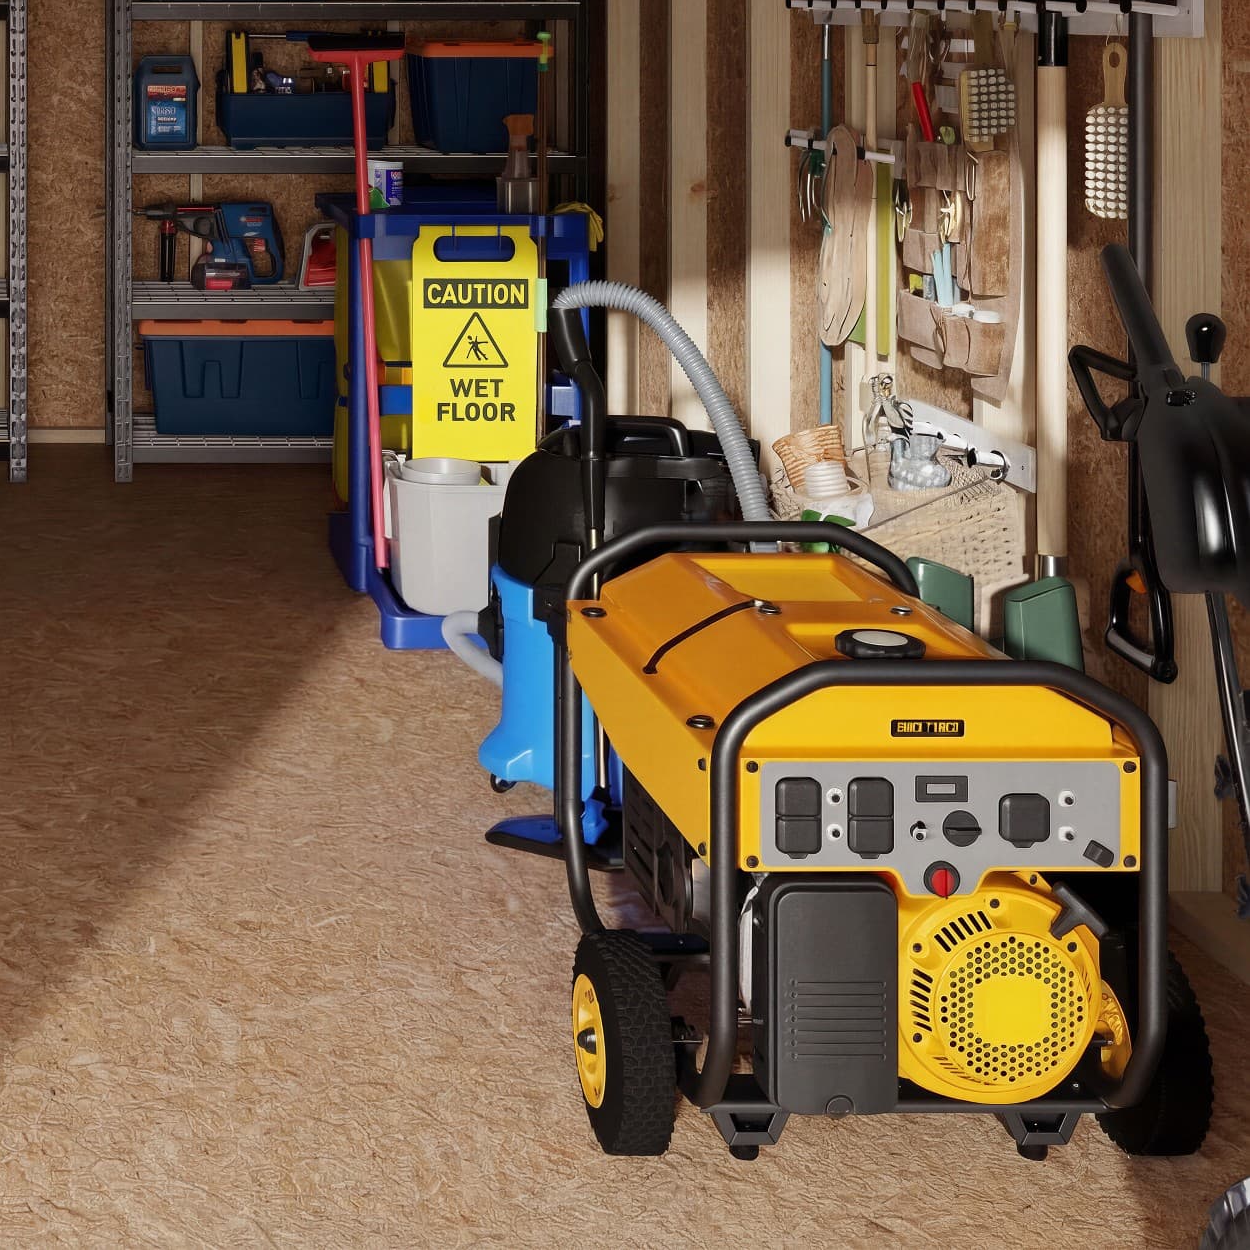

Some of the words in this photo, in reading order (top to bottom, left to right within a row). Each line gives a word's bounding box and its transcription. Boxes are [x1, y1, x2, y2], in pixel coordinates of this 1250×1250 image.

[427, 283, 526, 305] CAUTION
[450, 378, 504, 398] WET
[437, 402, 516, 422] FLOOR
